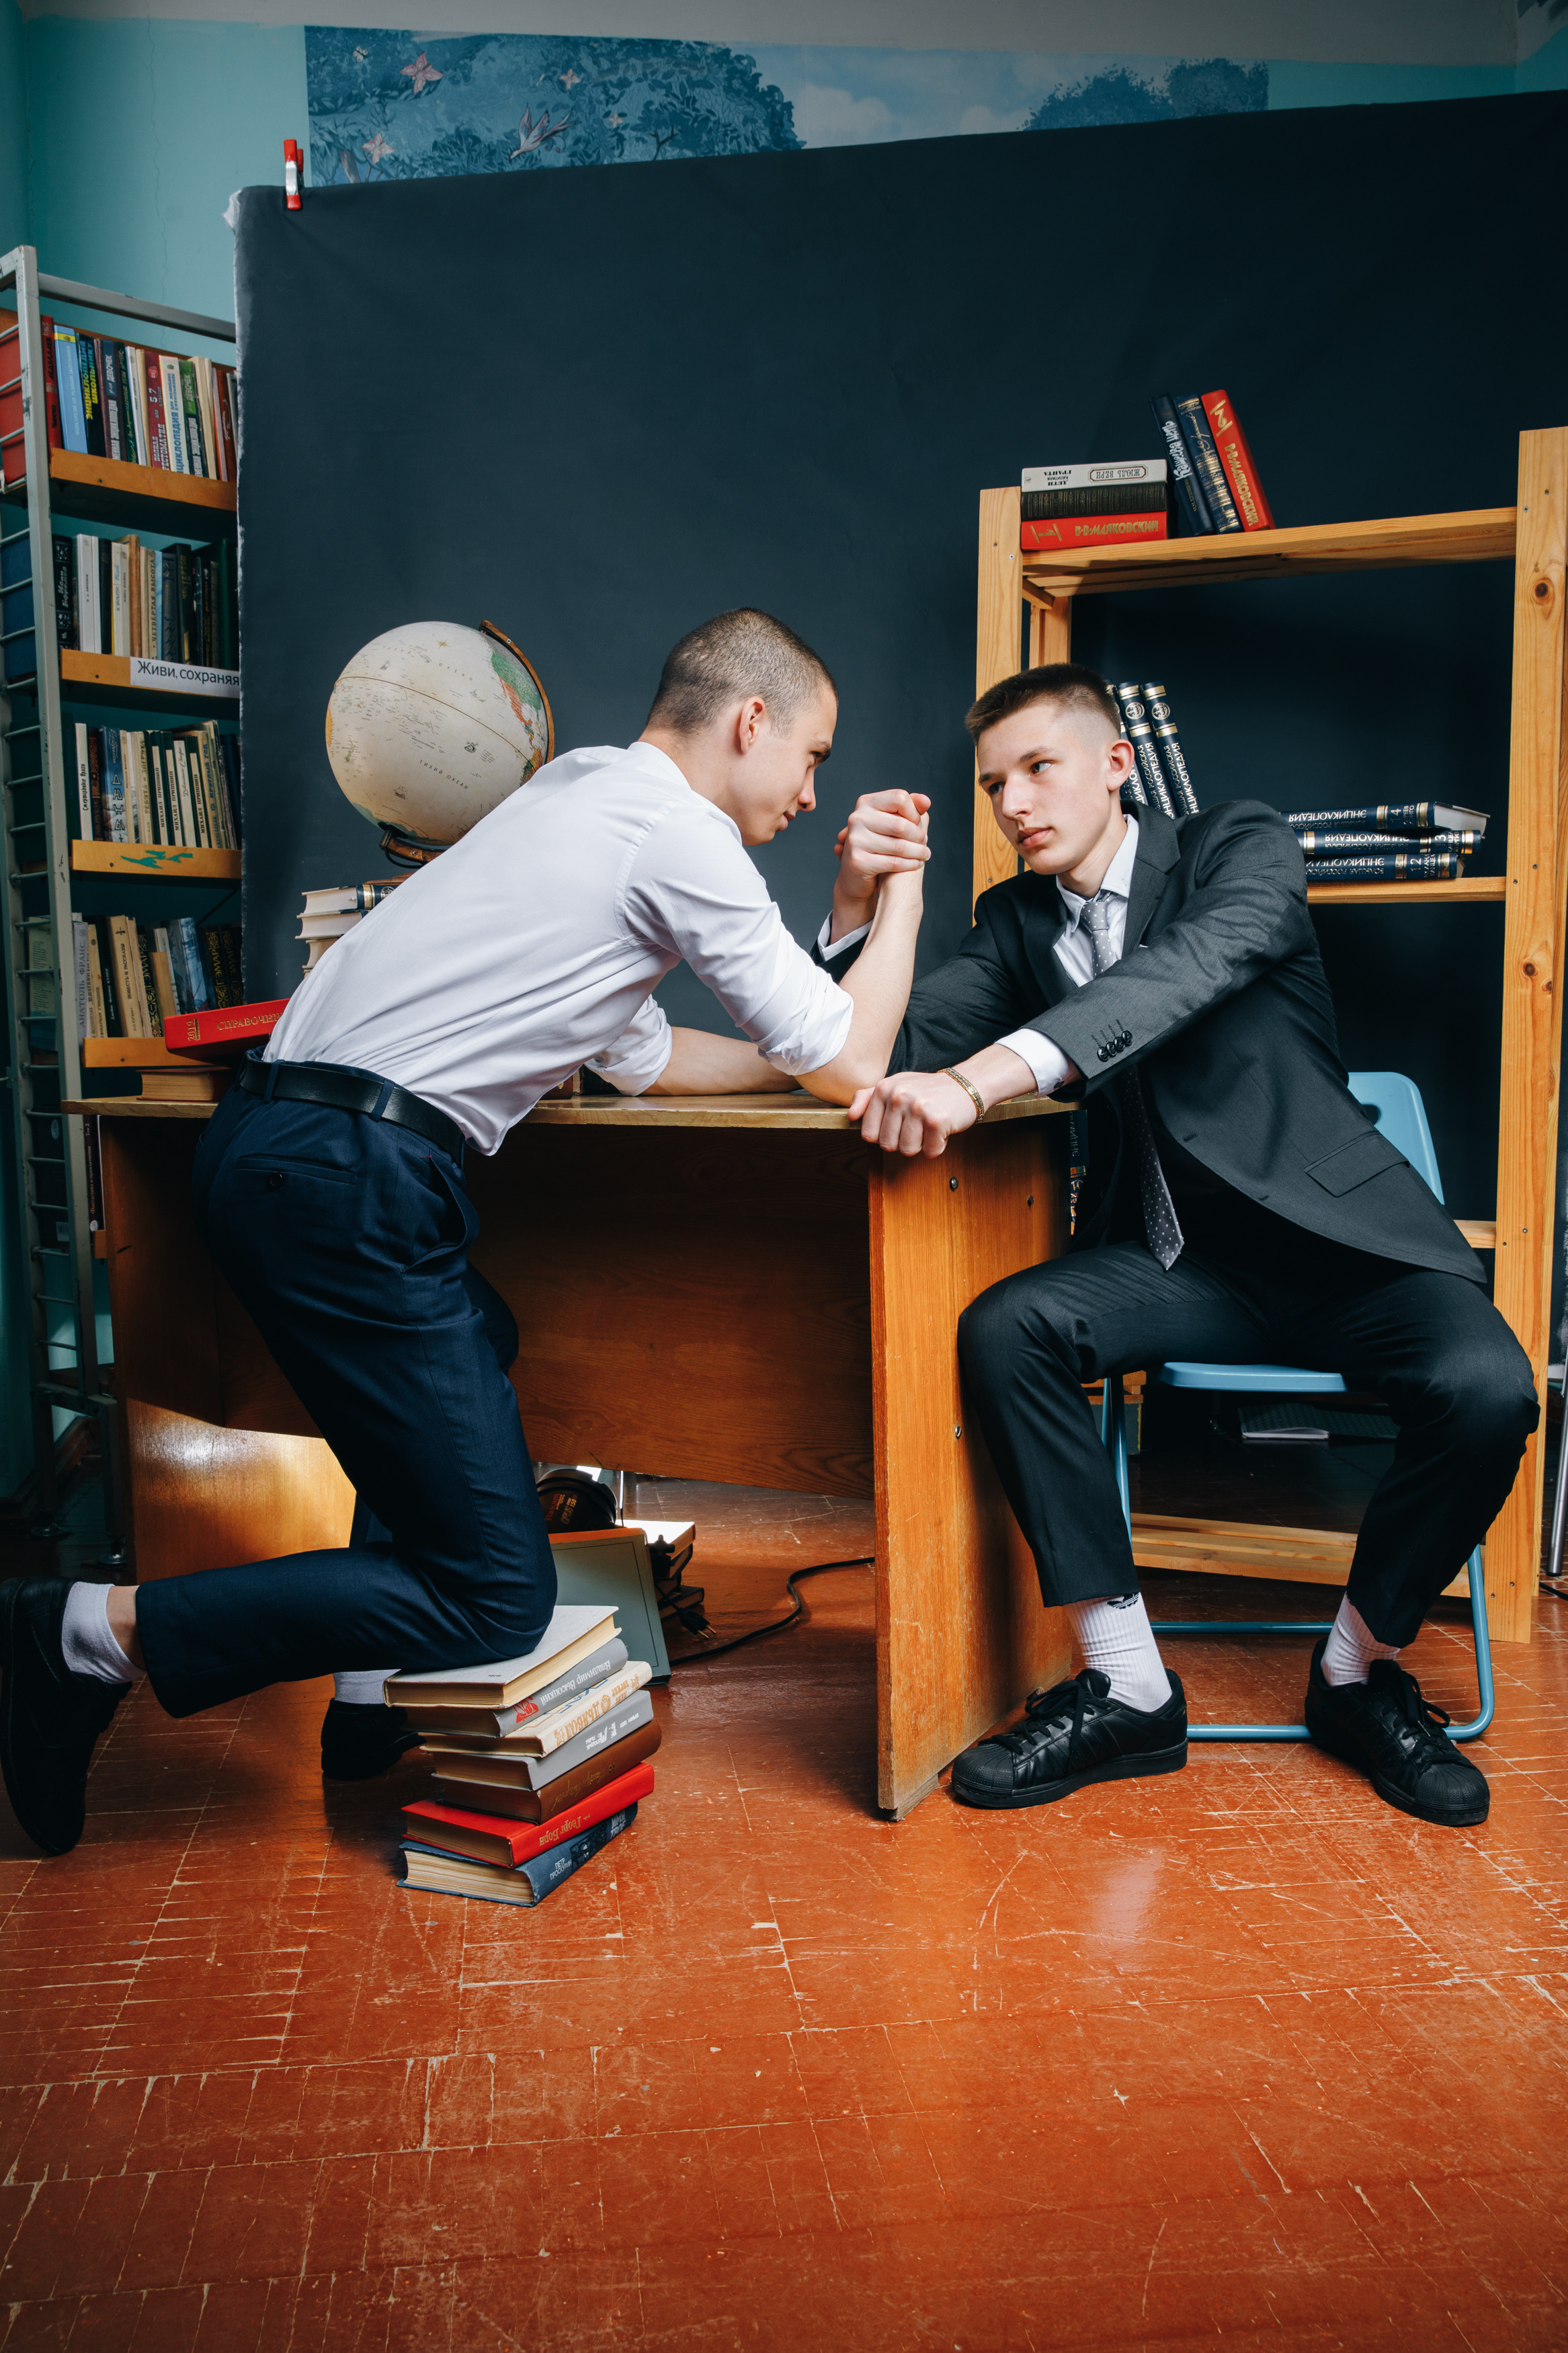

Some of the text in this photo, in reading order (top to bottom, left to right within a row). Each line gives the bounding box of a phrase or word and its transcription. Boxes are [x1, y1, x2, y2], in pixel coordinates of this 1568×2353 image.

[46, 337, 54, 380] АБДУЛЛАЕВ
[87, 342, 98, 403] ШКОЛЬНИКУ
[106, 355, 115, 383] ДЕВОЧЕК
[80, 341, 93, 420] ЭНЦИКЛОПЕДИЯ
[183, 374, 194, 401] ДЕВОЧЕК
[108, 399, 120, 440] ЭНЦИКЛОПЕДИЯ
[110, 440, 120, 460] МЕННАЯ
[152, 436, 160, 461] ПОЛНАЯ
[158, 424, 169, 470] РЕСТОМАТИЯ
[188, 417, 201, 455] ЭНЦИКЛОПЕДИЯ
[1096, 469, 1140, 479] ЖЮЛЬ ВЕРН
[138, 661, 239, 686] Живи, сохраняя
[204, 762, 214, 798] КРУГЛЫЙ
[419, 760, 468, 789] ТИХИЙ ОКЕАН
[1137, 744, 1155, 789] РОССИЙСКАЯ
[1145, 742, 1174, 820] ЭНЦИКЛОПЕДИЯ
[1163, 745, 1181, 789] РОССИЙСКАЯ
[1171, 742, 1199, 813] НЦИКЛОПЕДИЯ
[194, 774, 202, 804] ПРИШВИН
[1288, 809, 1366, 822] ЭНЦИКЛОПЕДИЯ
[1410, 858, 1421, 871] 12
[140, 951, 151, 980] ЭМАР
[212, 949, 220, 978] ЭМАР
[187, 1021, 195, 1041] 2019
[540, 1660, 610, 1706] Владимир Высоцкий
[565, 1700, 600, 1740] ДЬЯВОЛ
[560, 1816, 581, 1834] Георг
[612, 1808, 625, 1829] ИМЯ
[539, 1828, 559, 1846] Борн
[550, 1859, 572, 1880] ПРОСКУРИН
[554, 1858, 565, 1870] ПЕТР
